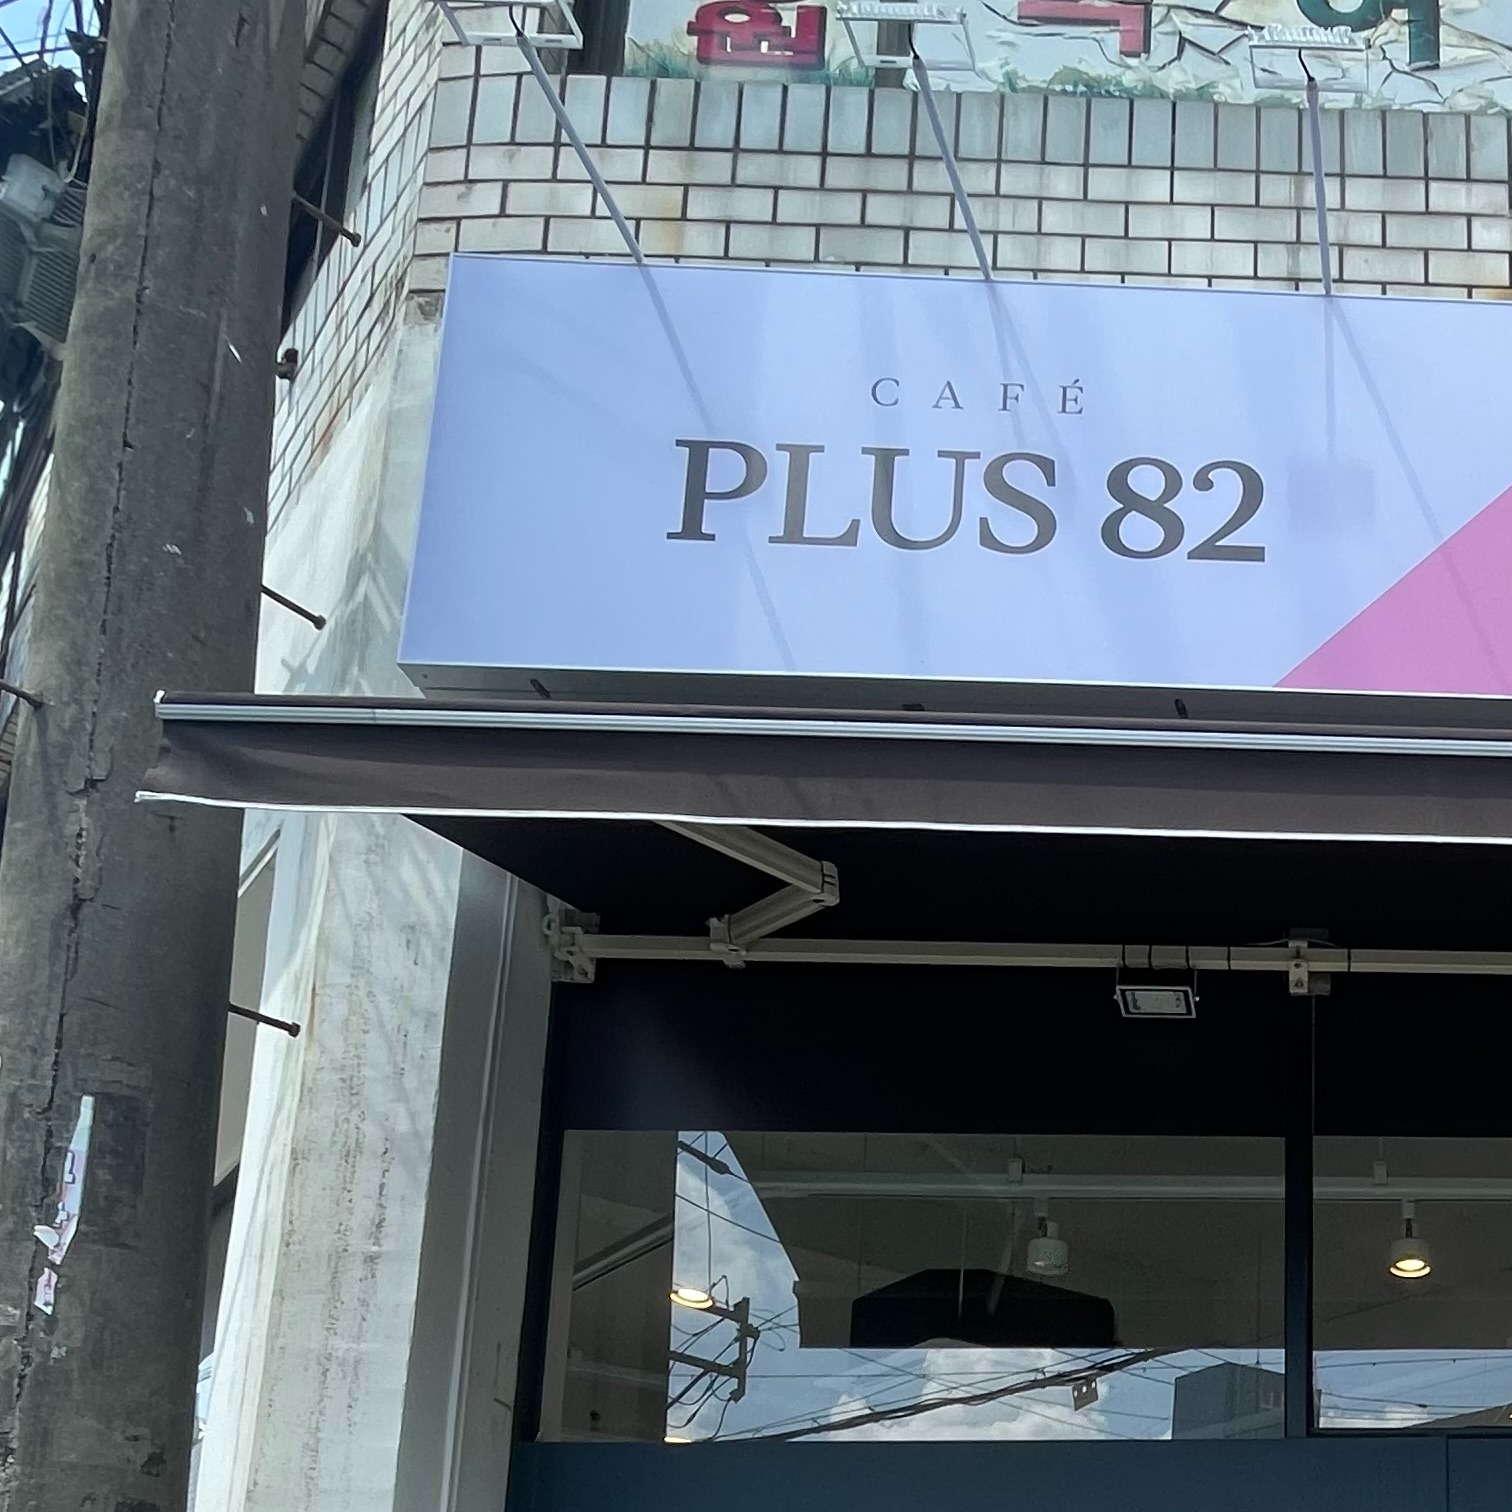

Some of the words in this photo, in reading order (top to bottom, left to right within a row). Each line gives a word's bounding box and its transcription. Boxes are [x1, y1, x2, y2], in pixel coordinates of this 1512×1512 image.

[871, 378, 1085, 414] CAFÉ
[666, 439, 1057, 555] PLUS
[1101, 457, 1265, 562] 82
